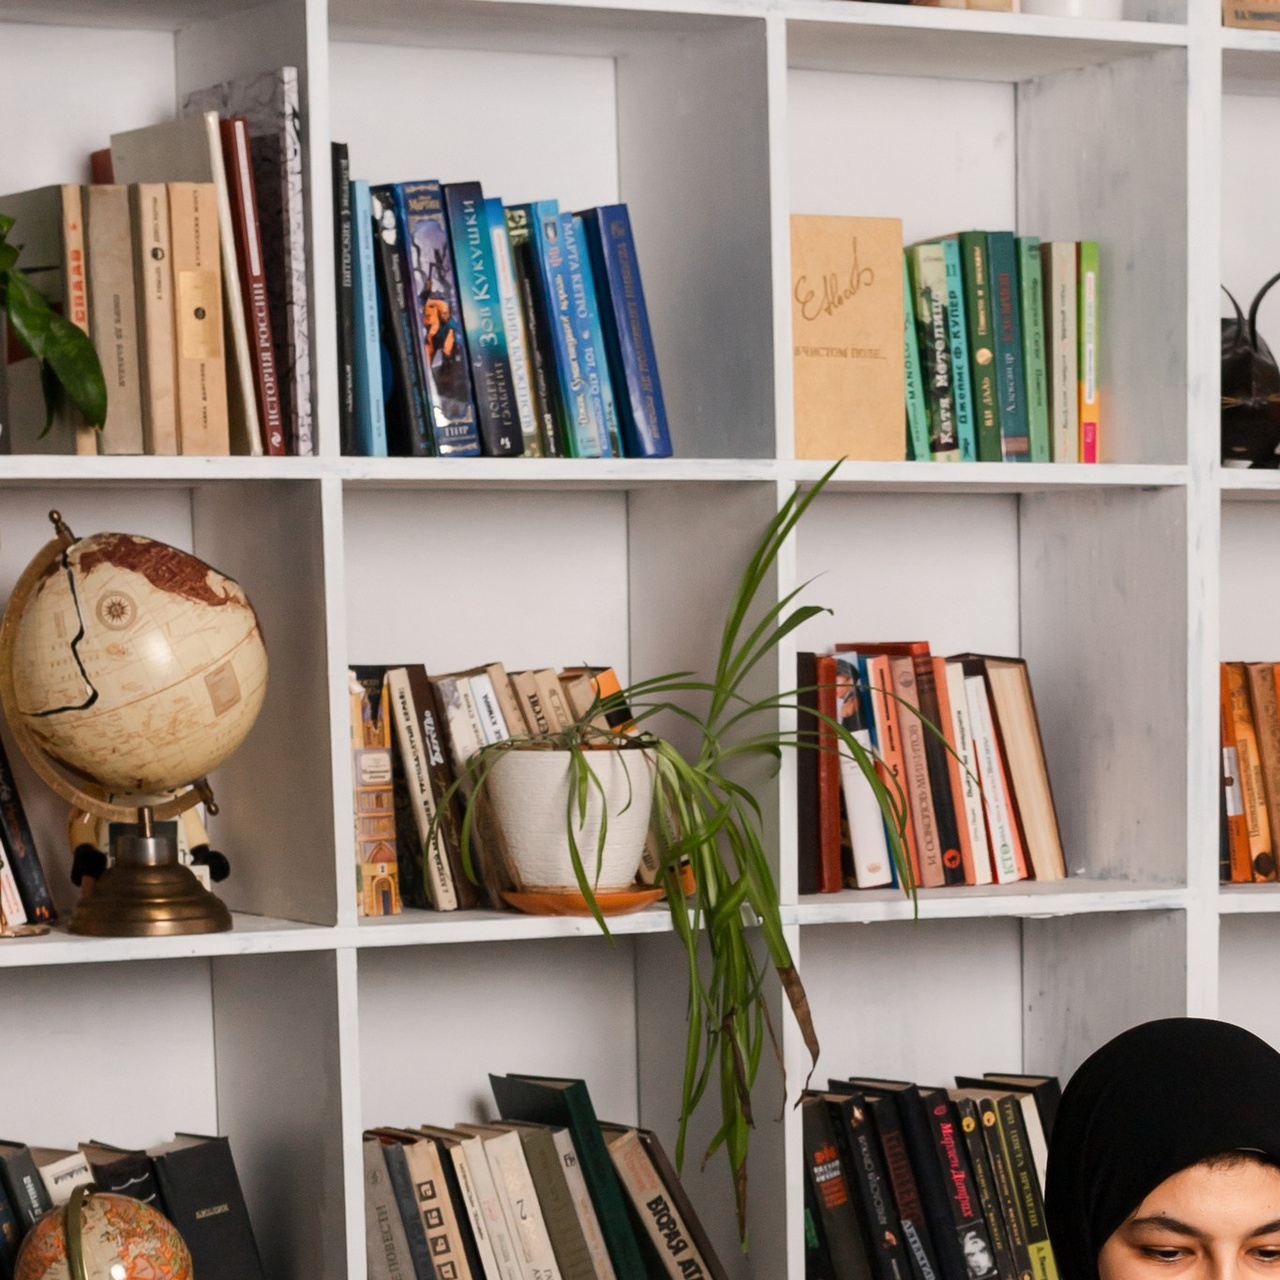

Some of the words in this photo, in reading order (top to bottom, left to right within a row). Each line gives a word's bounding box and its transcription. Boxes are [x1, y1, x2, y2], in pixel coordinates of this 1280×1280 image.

[560, 221, 579, 270] МАРТА
[251, 282, 271, 348] РОССИИ
[501, 296, 521, 343] КНИГА
[569, 272, 588, 320] КЕТРО
[474, 305, 498, 348] Зов
[947, 298, 962, 345] КУПЕР
[803, 345, 848, 359] ЧИСТОМ
[259, 351, 281, 426] ИСТОРИЯ
[936, 396, 955, 444] Катя
[934, 1119, 963, 1170] Марлен
[946, 1166, 977, 1220] Дитрих
[373, 1202, 401, 1273] ПОВЕСТИ
[643, 1193, 689, 1258] ВТОРАЯ
